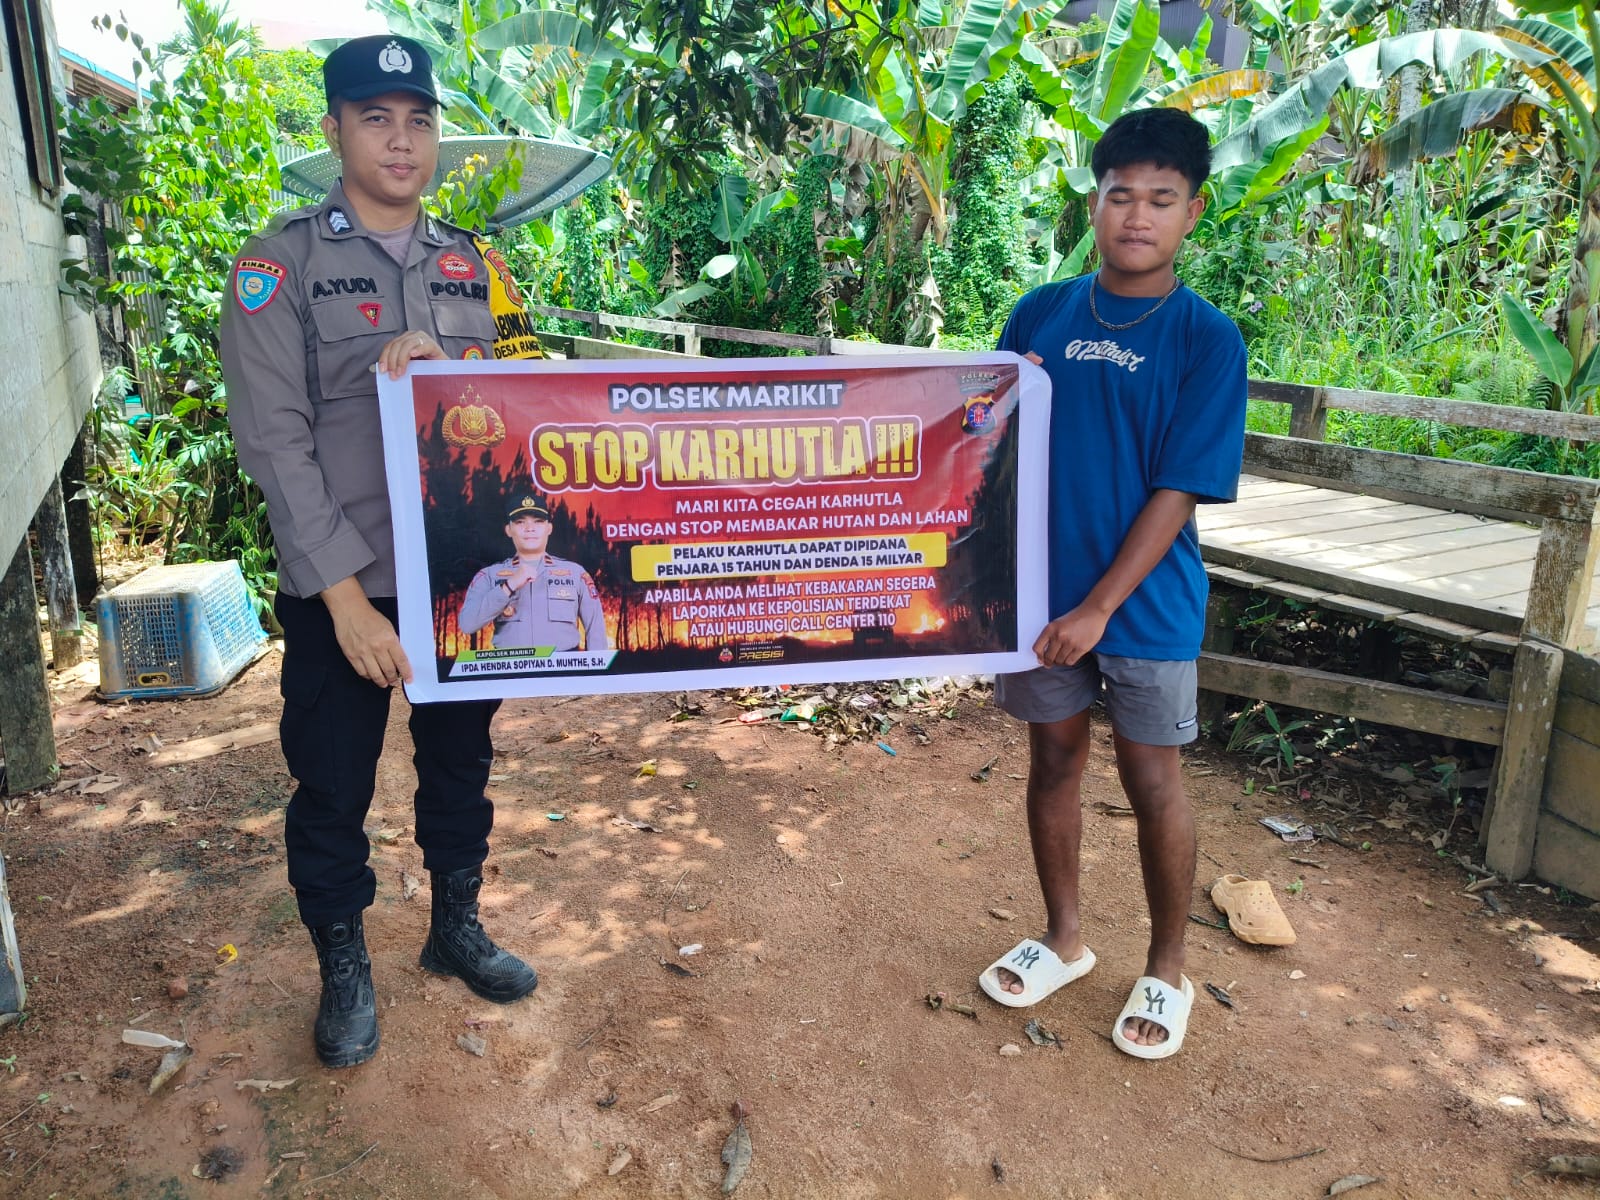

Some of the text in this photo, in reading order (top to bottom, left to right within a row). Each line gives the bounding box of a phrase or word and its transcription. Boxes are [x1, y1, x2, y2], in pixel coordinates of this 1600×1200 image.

[312, 277, 378, 299] A.YUDI
[430, 281, 488, 301] POLRI
[494, 343, 519, 359] DESA
[612, 384, 843, 410] POLSEK MARIKIT
[537, 422, 914, 485] STOP KARHUTLA !!!
[675, 492, 903, 514] MARI KITA CEGAH KARHUTLA
[606, 509, 968, 538] DENGAN STOP MEMBAKAR HUTAN DAN LAHAN
[673, 537, 907, 560] PELAKU KARHUTLA DAPAT DIPIDANA
[657, 552, 923, 577] PENJARA 15 TAHUN DAN DENDA 15 MILYAR
[644, 575, 937, 604] APABILA ANDA MELIHAT KEBAKARAN SEGERA
[672, 595, 912, 620] LAPORKAN KE KEPOLISIAN TERDEKAT
[690, 613, 896, 638] ATAU HUBUNGI CALL CENTER 110
[461, 663, 479, 673] IPDA
[480, 661, 512, 672] HENDRA
[513, 659, 546, 670] SOPIYAN
[556, 657, 590, 668] MUNTHE,
[591, 656, 606, 666] S.H.
[476, 649, 535, 659] KAPOLSEK MARIKIT
[739, 650, 785, 660] PRESISI
